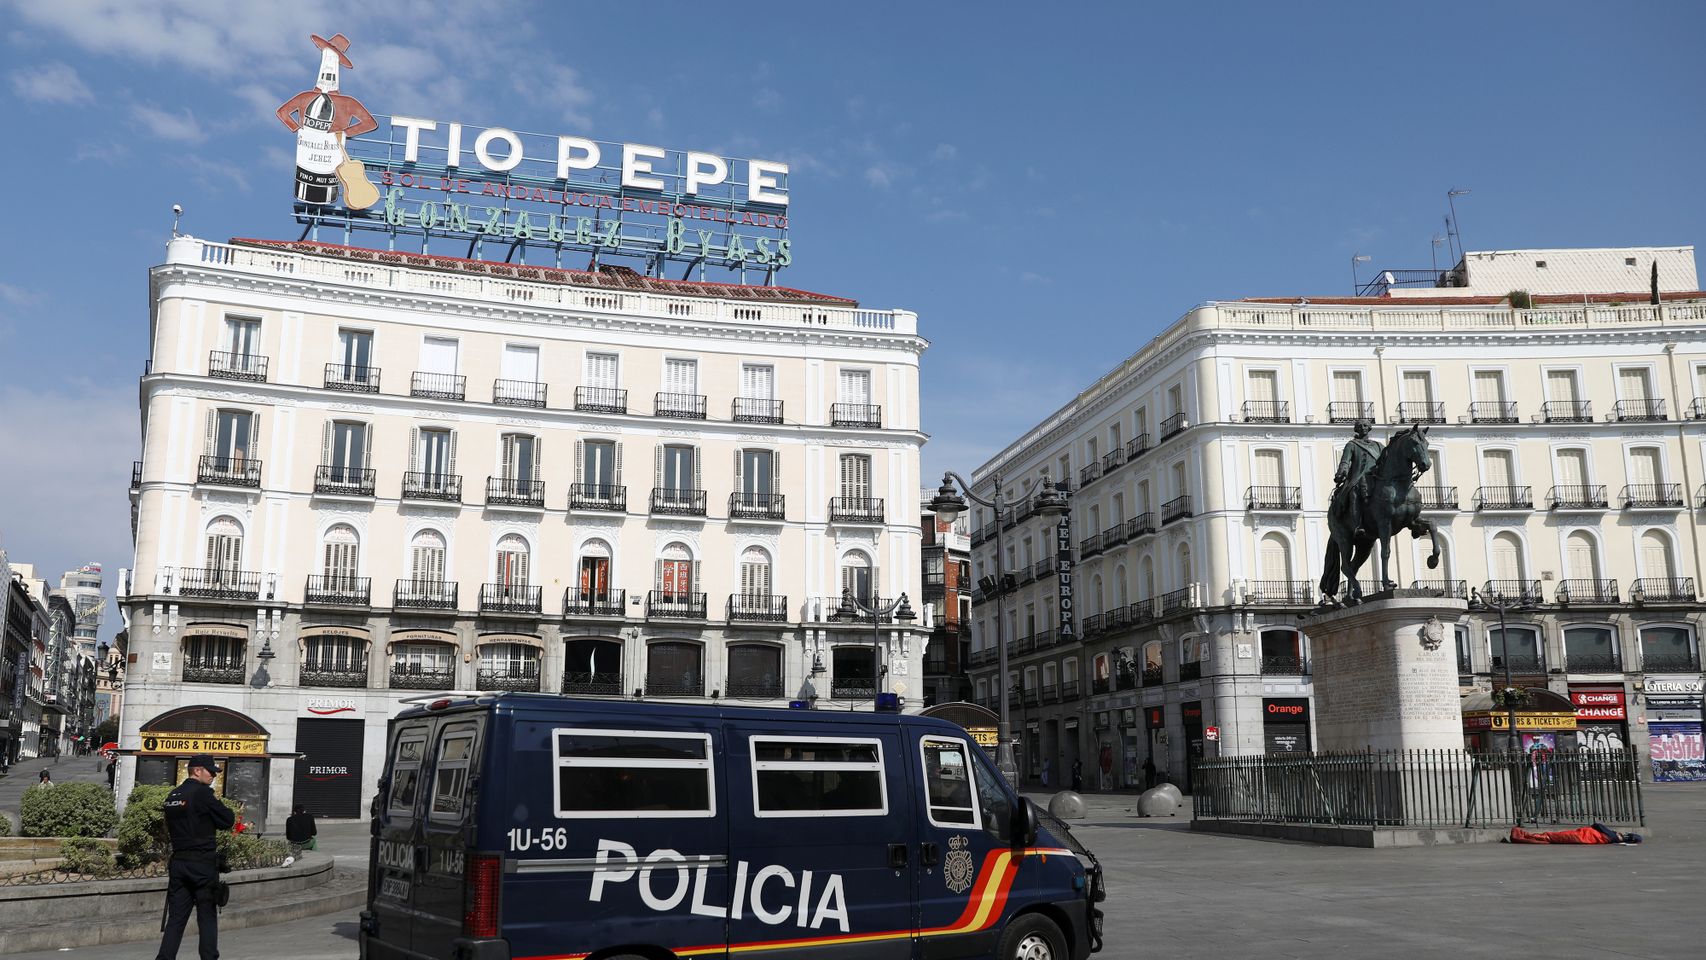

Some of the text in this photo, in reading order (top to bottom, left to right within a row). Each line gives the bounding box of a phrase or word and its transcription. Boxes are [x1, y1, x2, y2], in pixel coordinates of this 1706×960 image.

[308, 153, 332, 163] JEREZ
[391, 116, 789, 205] TIO PEPE
[299, 172, 313, 181] FINO
[382, 172, 788, 229] SOL DE ANDALUCIA EMBOTELLADO
[384, 187, 792, 267] GONZALEZ BYASS
[1058, 491, 1072, 635] HTEL EUROPA
[1685, 682, 1702, 691] SOL
[308, 698, 355, 709] PRIMOR
[1268, 704, 1302, 714] Orange
[1578, 708, 1623, 716] CHANGE
[1534, 718, 1560, 726] TICKETS
[160, 739, 189, 749] TOURS
[192, 741, 199, 750] &
[203, 741, 241, 751] TICKETS
[309, 766, 348, 774] PRIMOR
[507, 827, 568, 851] 1U-56
[378, 841, 414, 870] POLICIA
[589, 838, 850, 933] POLICIA
